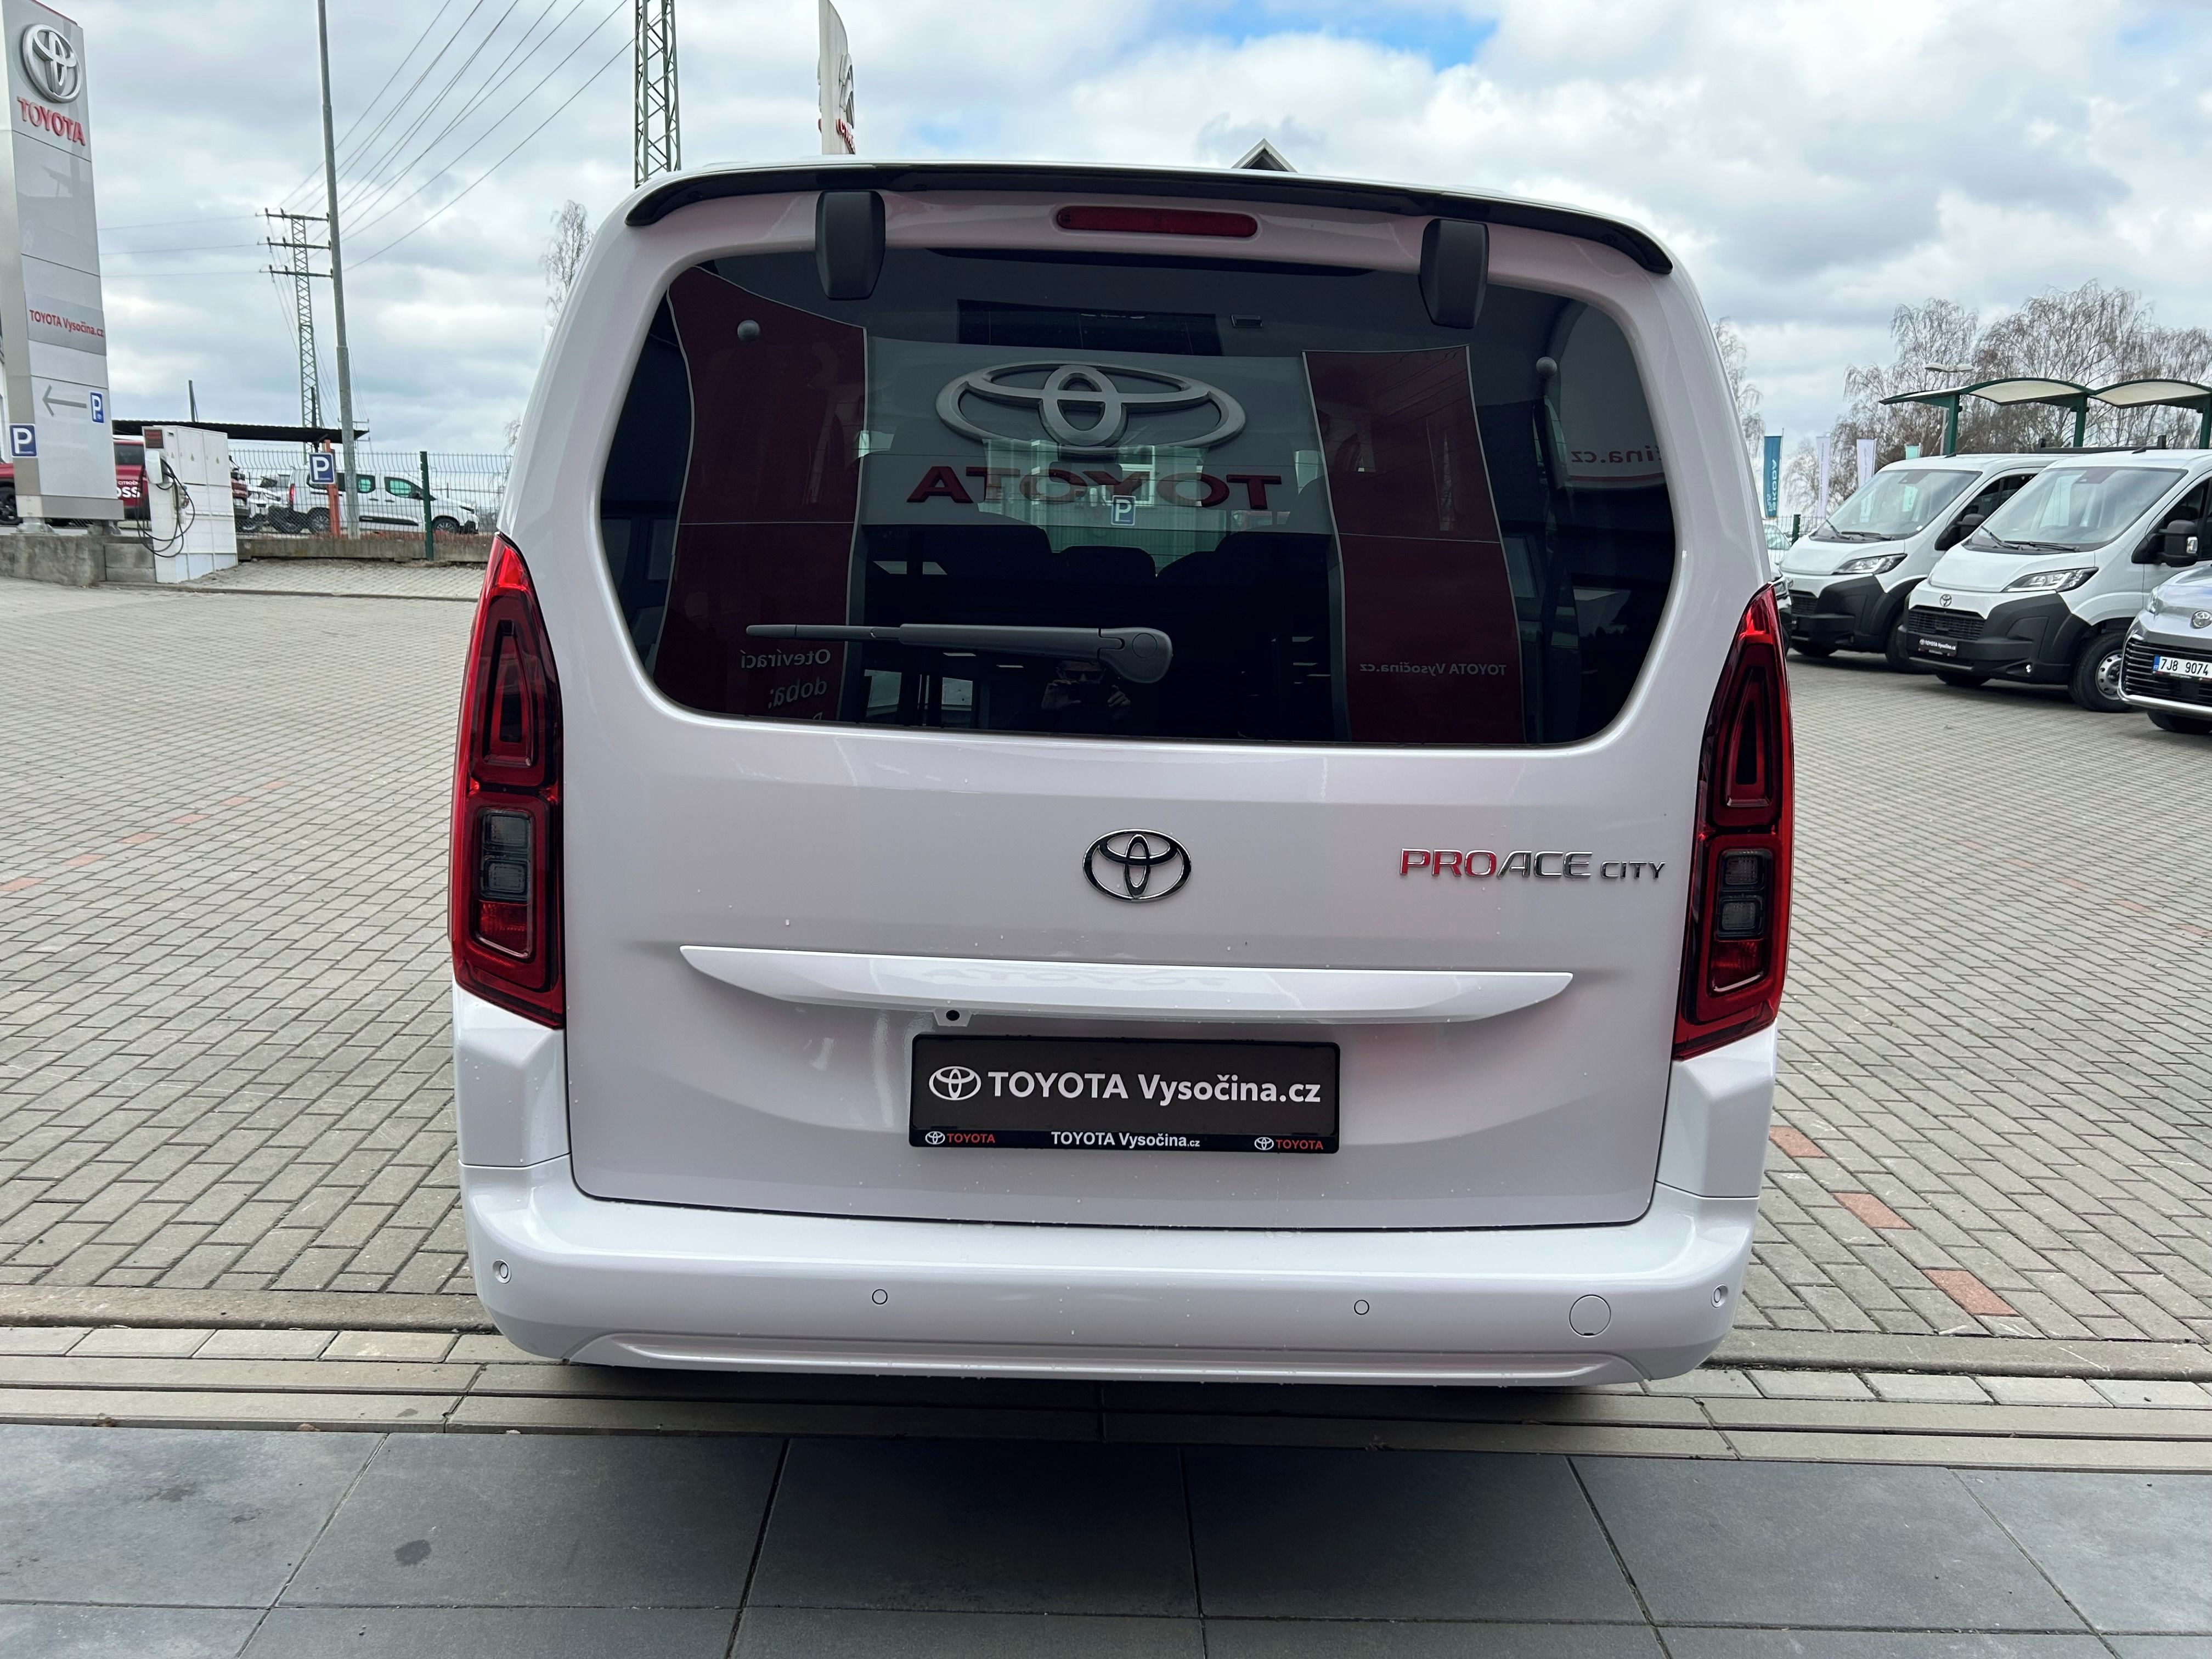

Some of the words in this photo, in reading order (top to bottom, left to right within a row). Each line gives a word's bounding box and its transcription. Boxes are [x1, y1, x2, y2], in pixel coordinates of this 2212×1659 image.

[16, 96, 86, 146] TOYOTA
[29, 309, 62, 328] TOYOTA
[62, 317, 104, 337] Vysočina.cz
[92, 395, 101, 420] P
[13, 427, 32, 454] P
[312, 456, 329, 481] P
[1115, 499, 1132, 522] P
[2161, 658, 2179, 671] 7J8
[2185, 662, 2209, 675] 9074
[1399, 848, 1593, 878] PROACE
[1600, 860, 1666, 879] CITY
[988, 1071, 1128, 1099] TOYOTA
[1138, 1074, 1321, 1106] Vysočina.cz
[946, 1133, 996, 1143] TOYOTA
[1051, 1131, 1115, 1146] TOYOTA
[1119, 1132, 1200, 1149] Vysočina.cz
[1276, 1139, 1324, 1150] TOYOTA
